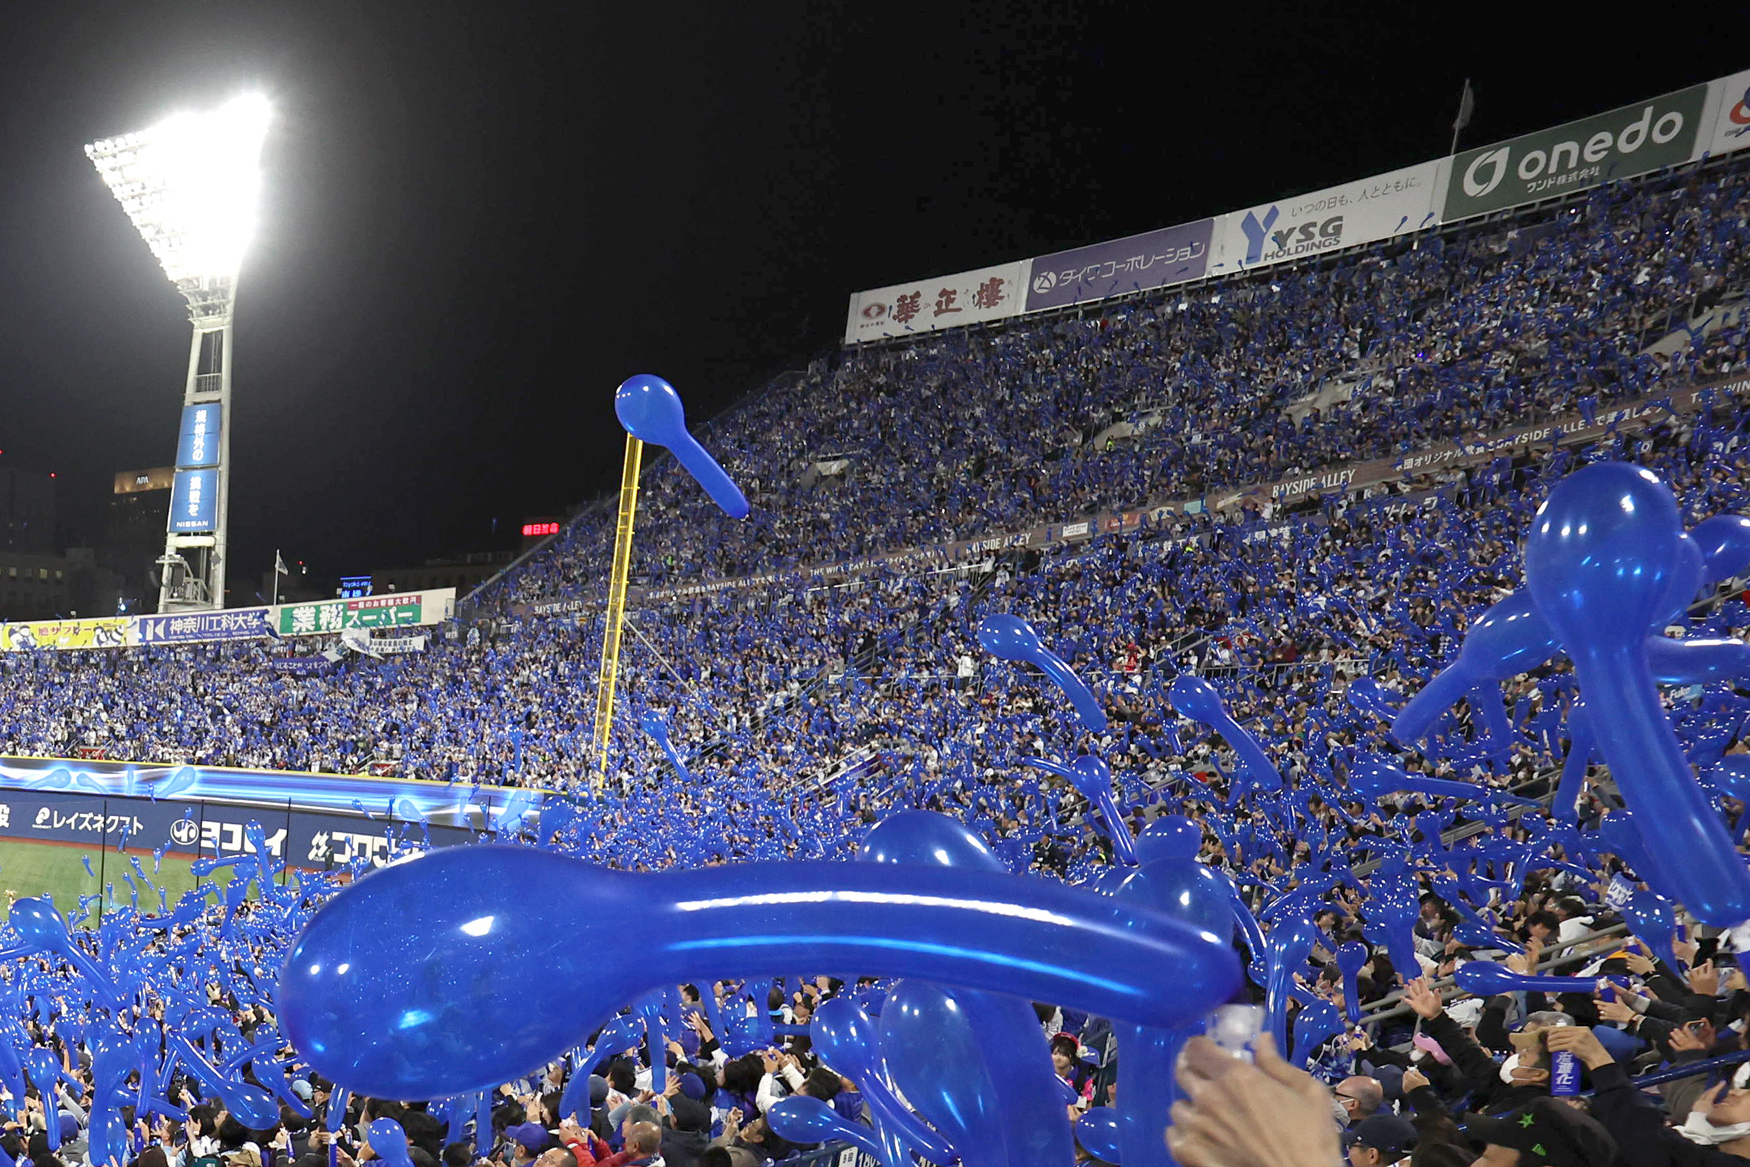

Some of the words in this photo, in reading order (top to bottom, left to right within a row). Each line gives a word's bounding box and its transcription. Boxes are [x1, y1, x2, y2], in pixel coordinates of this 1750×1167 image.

[1518, 105, 1684, 180] onedo
[1526, 166, 1601, 194] ワンド株式会社
[1274, 215, 1344, 249] YSG
[1263, 235, 1341, 261] HOLDINGS
[176, 520, 209, 528] NISSAN
[170, 612, 261, 635] 神奈川工科大学
[292, 603, 413, 632] 業務スーパー
[53, 810, 144, 836] レイズネクスト
